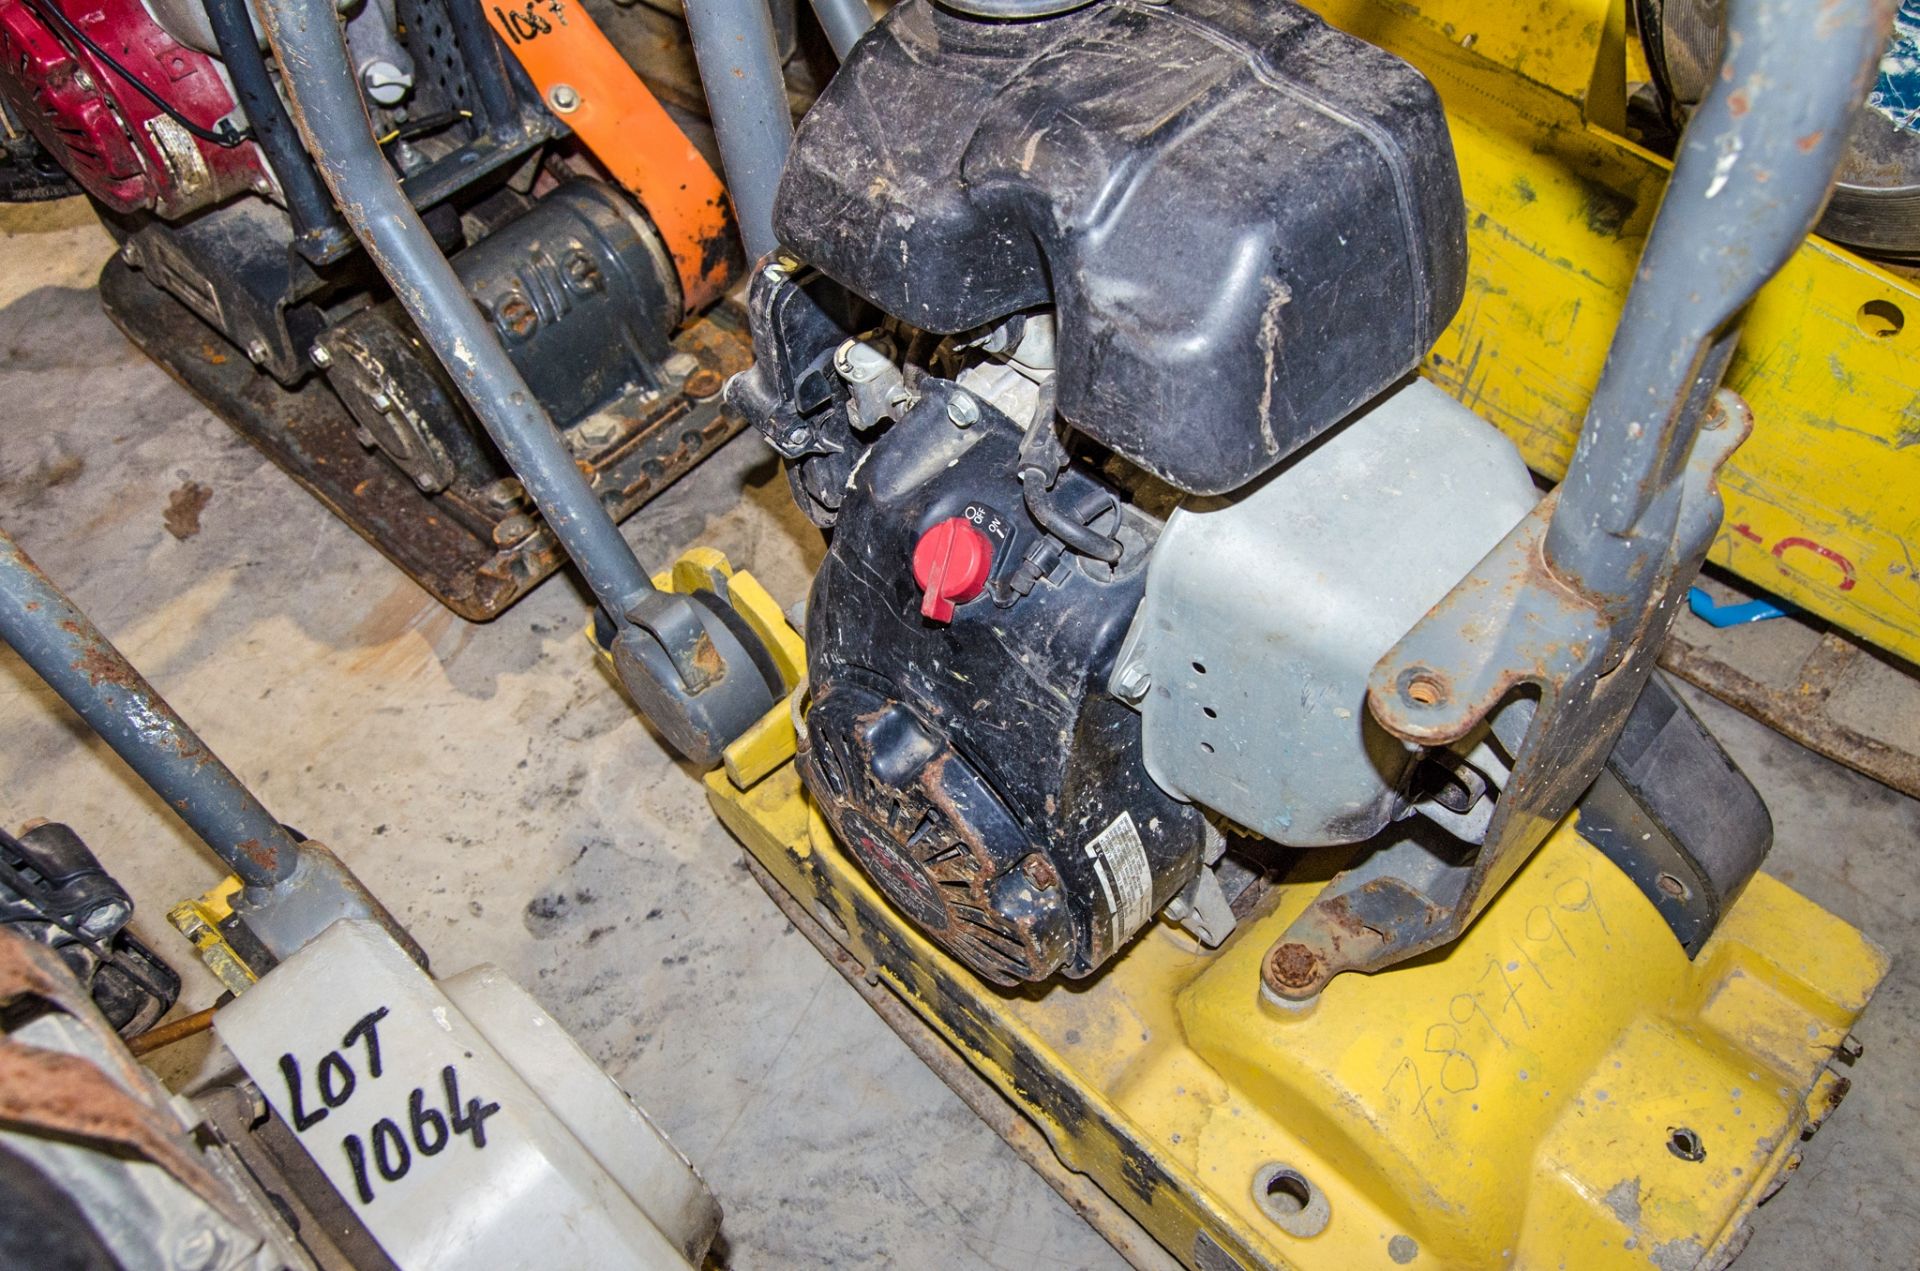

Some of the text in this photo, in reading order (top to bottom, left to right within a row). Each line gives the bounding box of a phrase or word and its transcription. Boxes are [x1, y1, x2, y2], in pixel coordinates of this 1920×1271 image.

[973, 507, 986, 525] OFF
[988, 517, 1001, 533] ON
[279, 1005, 390, 1133] LOT
[343, 1065, 501, 1205] 1064
